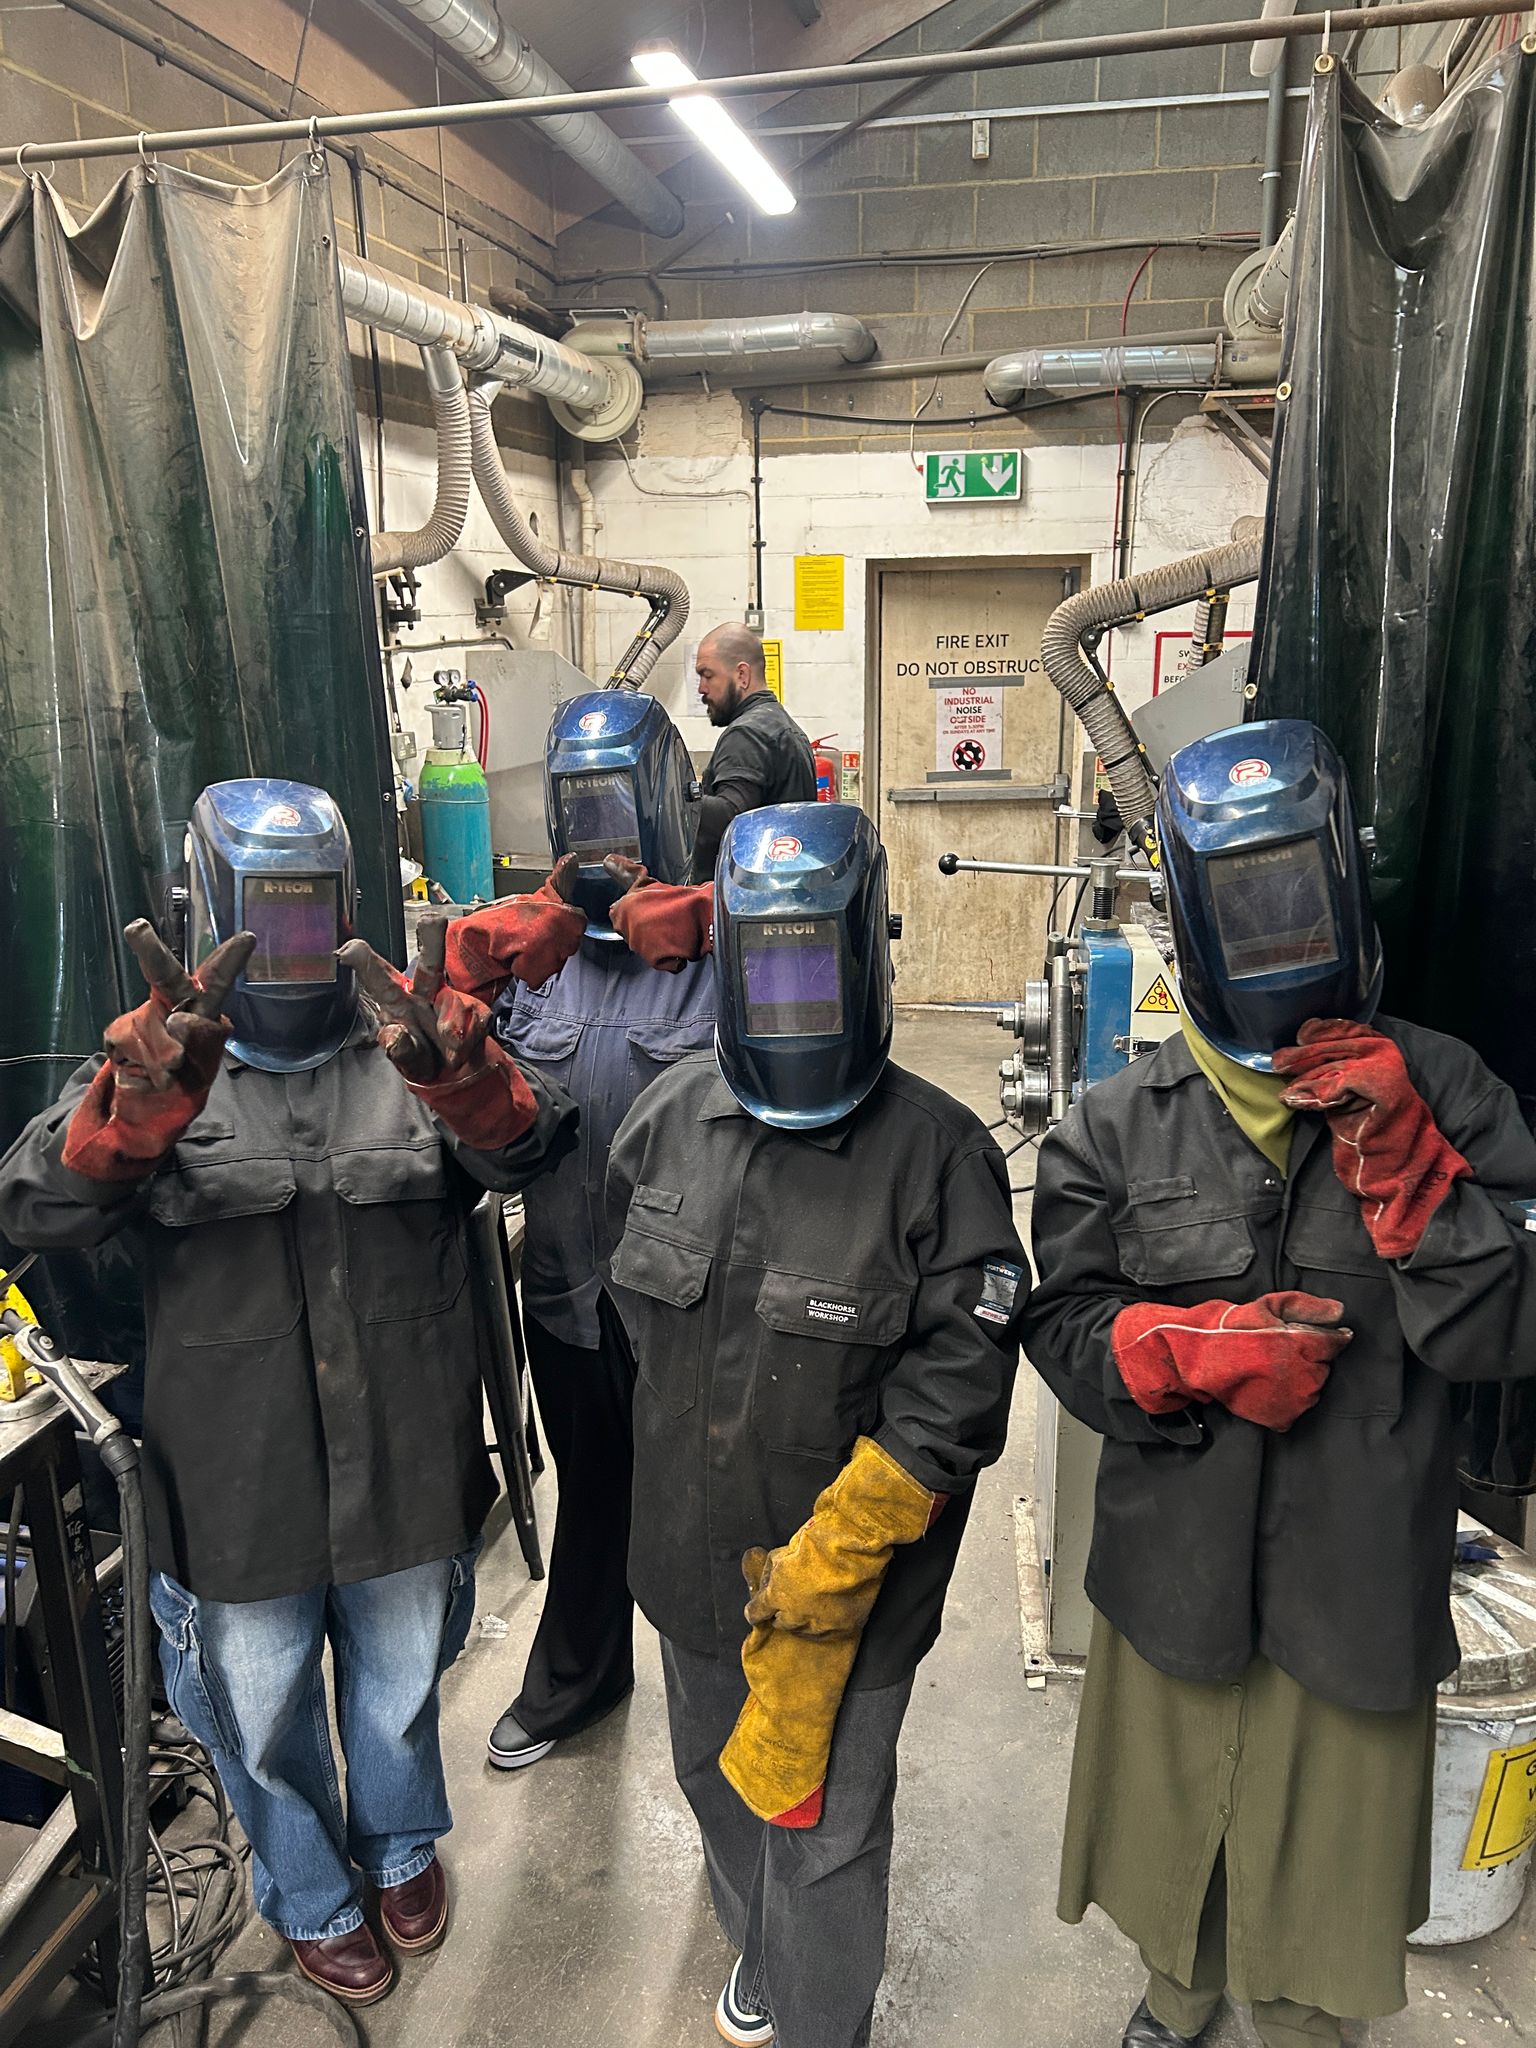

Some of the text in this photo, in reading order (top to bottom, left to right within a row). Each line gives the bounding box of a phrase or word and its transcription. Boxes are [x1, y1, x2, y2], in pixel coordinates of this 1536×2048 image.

[936, 634, 1009, 649] FIRE EXIT
[897, 663, 919, 676] DO
[926, 661, 958, 675] NOT
[944, 696, 994, 705] INDUSTRIAL
[956, 706, 982, 714] NOISE
[950, 715, 986, 724] OUTSIDE
[264, 882, 313, 893] R-TECH
[763, 922, 816, 935] R-TECH
[809, 1299, 856, 1313] BLACKHORSE
[808, 1310, 849, 1323] WORKSHOP
